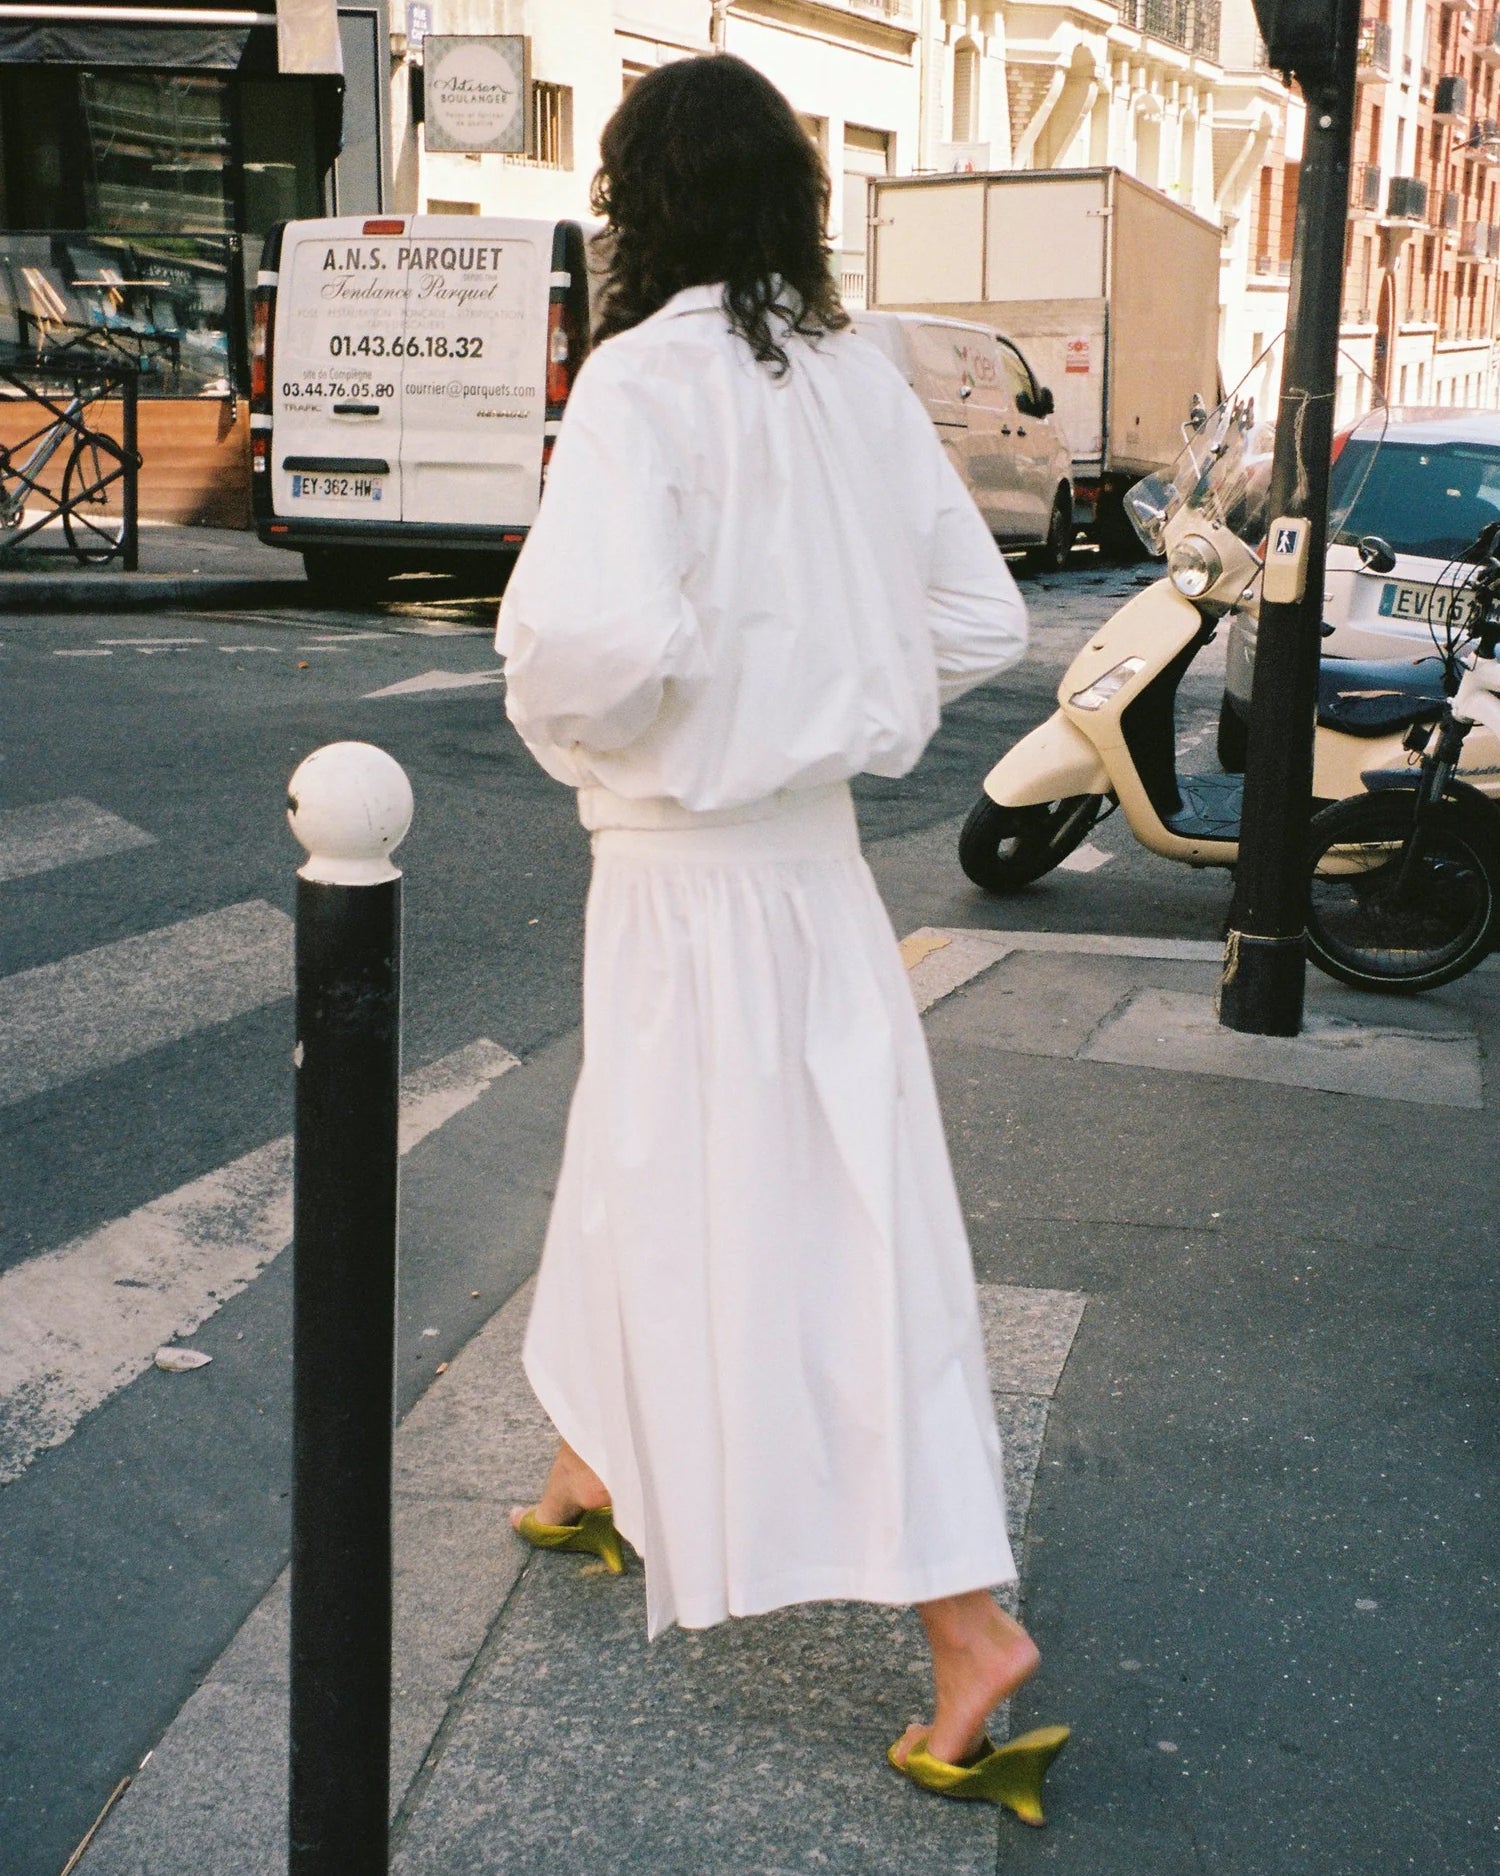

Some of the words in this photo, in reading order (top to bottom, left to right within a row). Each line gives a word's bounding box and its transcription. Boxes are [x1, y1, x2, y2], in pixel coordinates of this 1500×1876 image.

[433, 76, 513, 95] Artisan
[441, 93, 507, 104] BOULANGER
[323, 248, 387, 271] A.N.S.
[397, 247, 503, 271] PARQUET
[320, 274, 412, 301] Tendance
[417, 273, 499, 306] Parquet
[329, 334, 484, 359] 01.43.66.18.32
[282, 382, 395, 398] 03.44.76.05.80
[405, 380, 536, 400] courrier@parquets.com
